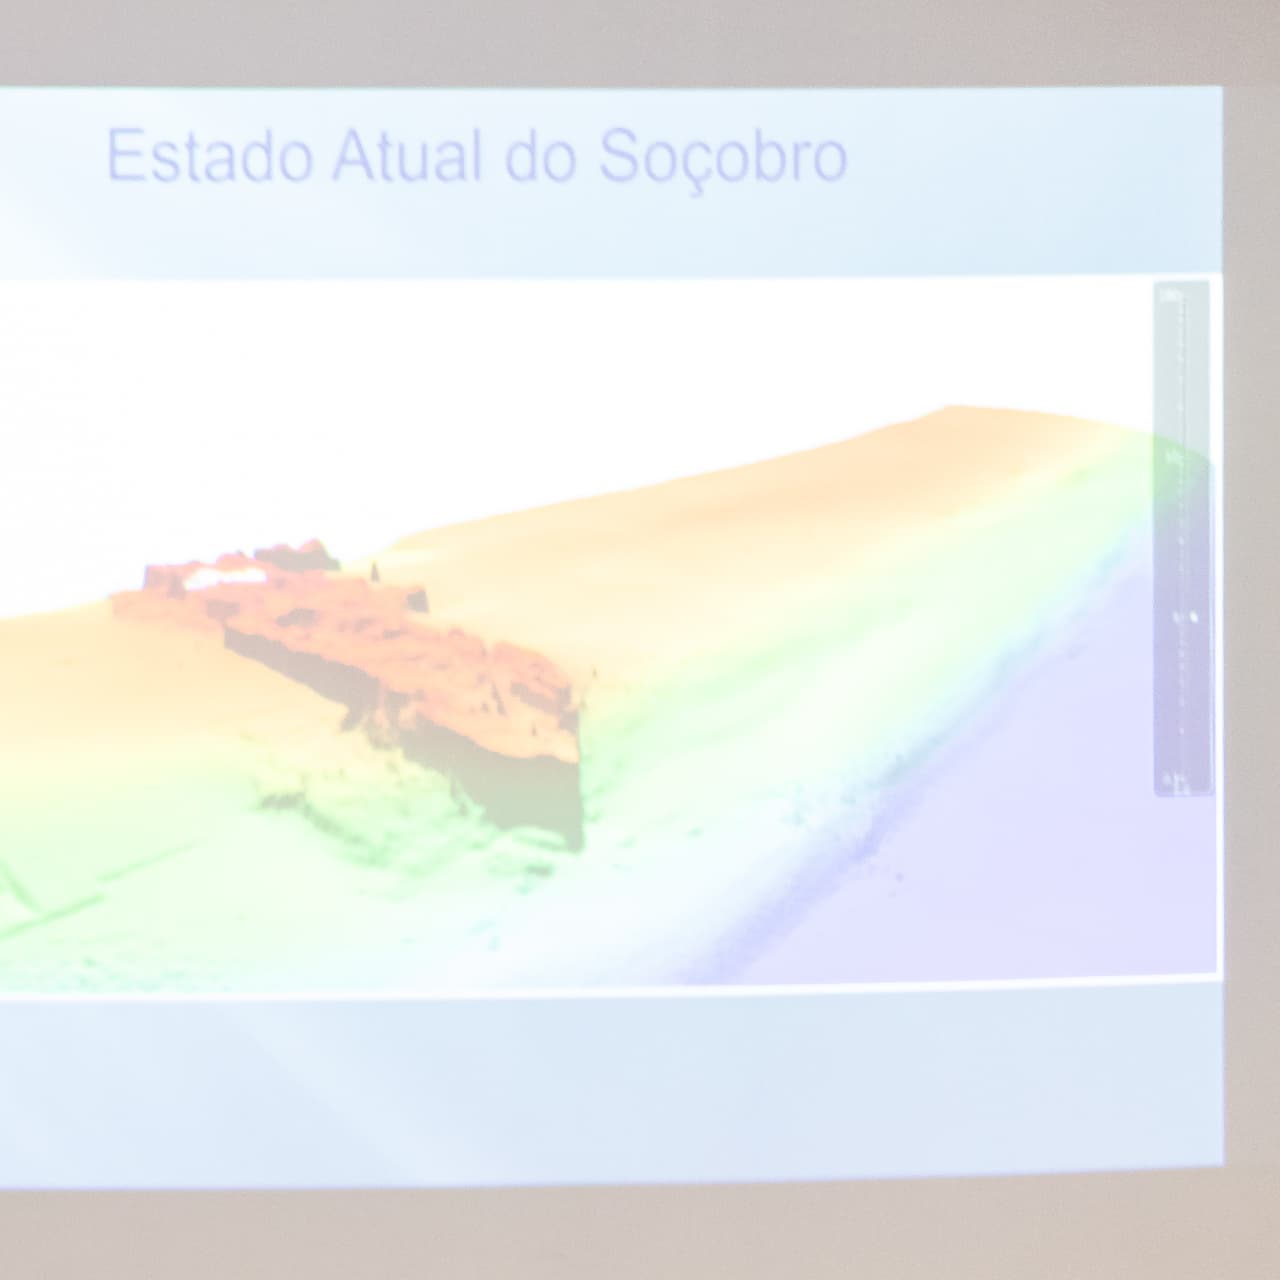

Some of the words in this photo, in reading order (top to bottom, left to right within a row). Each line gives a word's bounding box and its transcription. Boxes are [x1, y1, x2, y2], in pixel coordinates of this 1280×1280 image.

[109, 127, 314, 184] Estado
[333, 127, 482, 184] Atual
[506, 128, 578, 184] do
[601, 127, 849, 199] Soçobro
